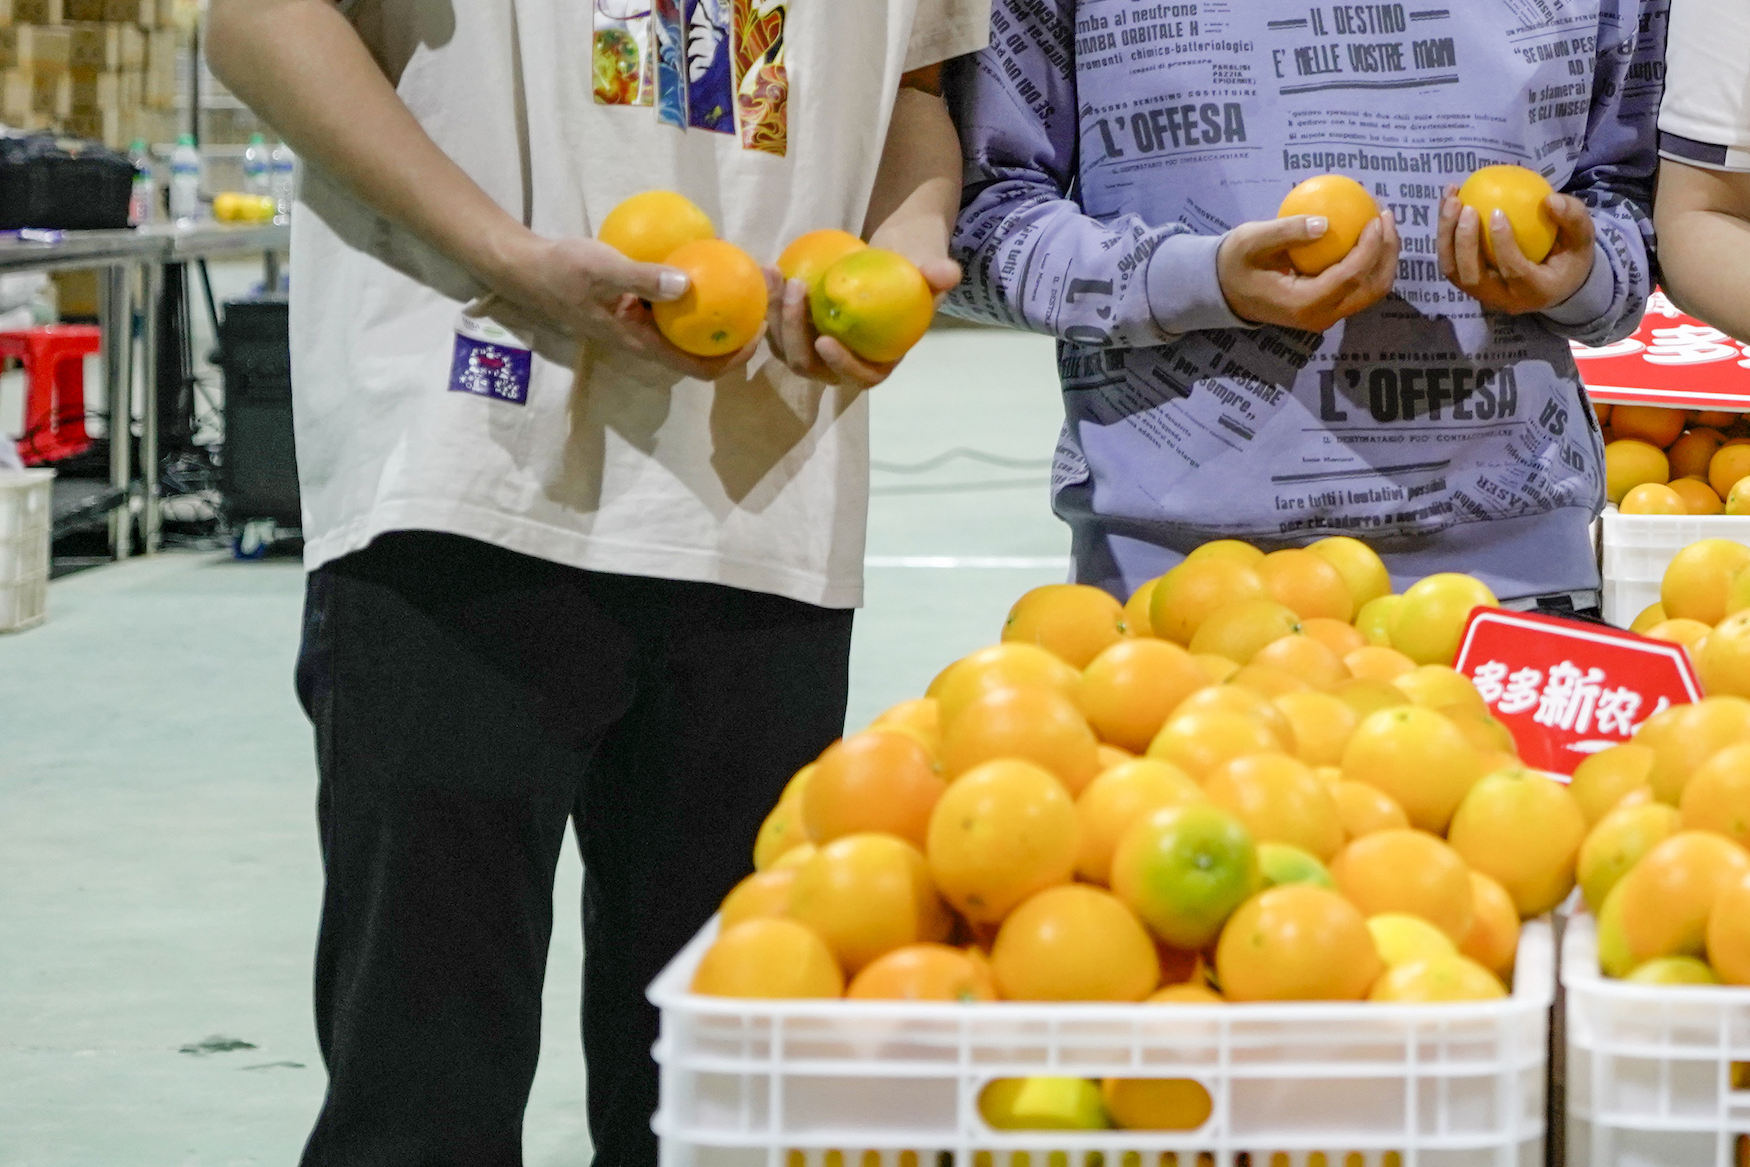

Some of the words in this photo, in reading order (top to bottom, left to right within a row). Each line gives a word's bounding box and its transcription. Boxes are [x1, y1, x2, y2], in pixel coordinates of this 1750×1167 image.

[1115, 10, 1127, 26] al
[1132, 3, 1197, 23] neutrone
[1310, 8, 1328, 36] IL
[1333, 3, 1406, 34] DESTINO
[1004, 31, 1028, 56] AD
[1122, 21, 1183, 47] ORBITALE
[1190, 20, 1199, 36] H
[999, 55, 1023, 81] UN
[1294, 44, 1343, 76] NELLE
[1347, 42, 1406, 72] VOSTRE
[1568, 59, 1584, 75] AD
[1098, 102, 1246, 158] L'OFFESA
[1375, 182, 1389, 197] AL
[1316, 367, 1518, 423] L'OFFESA
